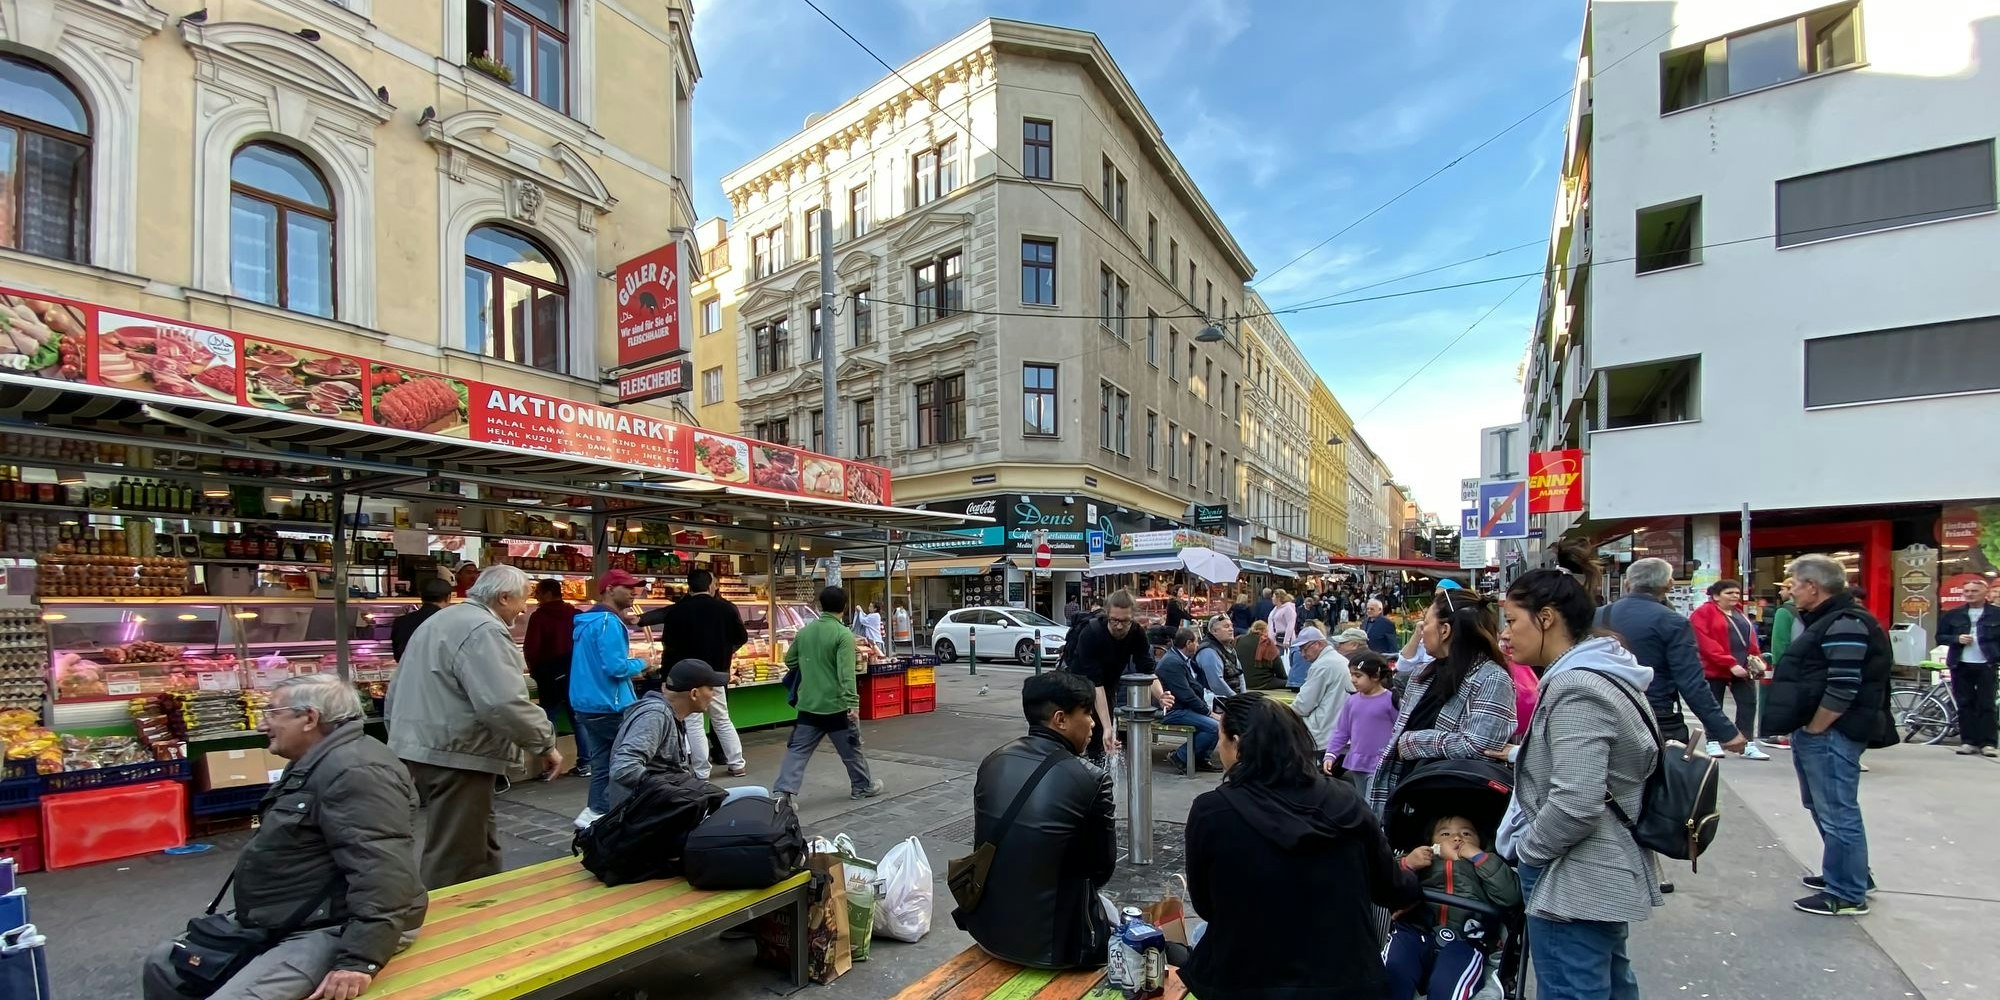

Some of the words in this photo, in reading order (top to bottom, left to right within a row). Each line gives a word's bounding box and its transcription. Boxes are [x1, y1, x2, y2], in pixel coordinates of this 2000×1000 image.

[618, 263, 657, 306] GÜLER
[658, 265, 676, 291] ET
[620, 327, 631, 338] Wir
[632, 321, 644, 335] sind
[645, 320, 654, 331] für
[655, 317, 664, 328] Sie
[627, 326, 669, 347] FLEISCHHAUER
[620, 366, 681, 397] FLEISCHEREI
[487, 389, 678, 443] AKTIONMARKT
[487, 417, 526, 430] HALAL
[612, 438, 636, 448] RIND
[641, 442, 679, 455] FLEISCH
[487, 428, 521, 439] HELAL
[526, 433, 553, 443] KUZU
[558, 439, 574, 447] ETI
[588, 443, 611, 453] DANA
[616, 448, 630, 457] ETI
[666, 456, 679, 464] ETI
[1529, 473, 1580, 488] ENNY
[1462, 489, 1478, 499] gebi
[1539, 488, 1570, 497] MARKT
[1014, 502, 1075, 525] Denis
[1943, 521, 1977, 530] Einfach
